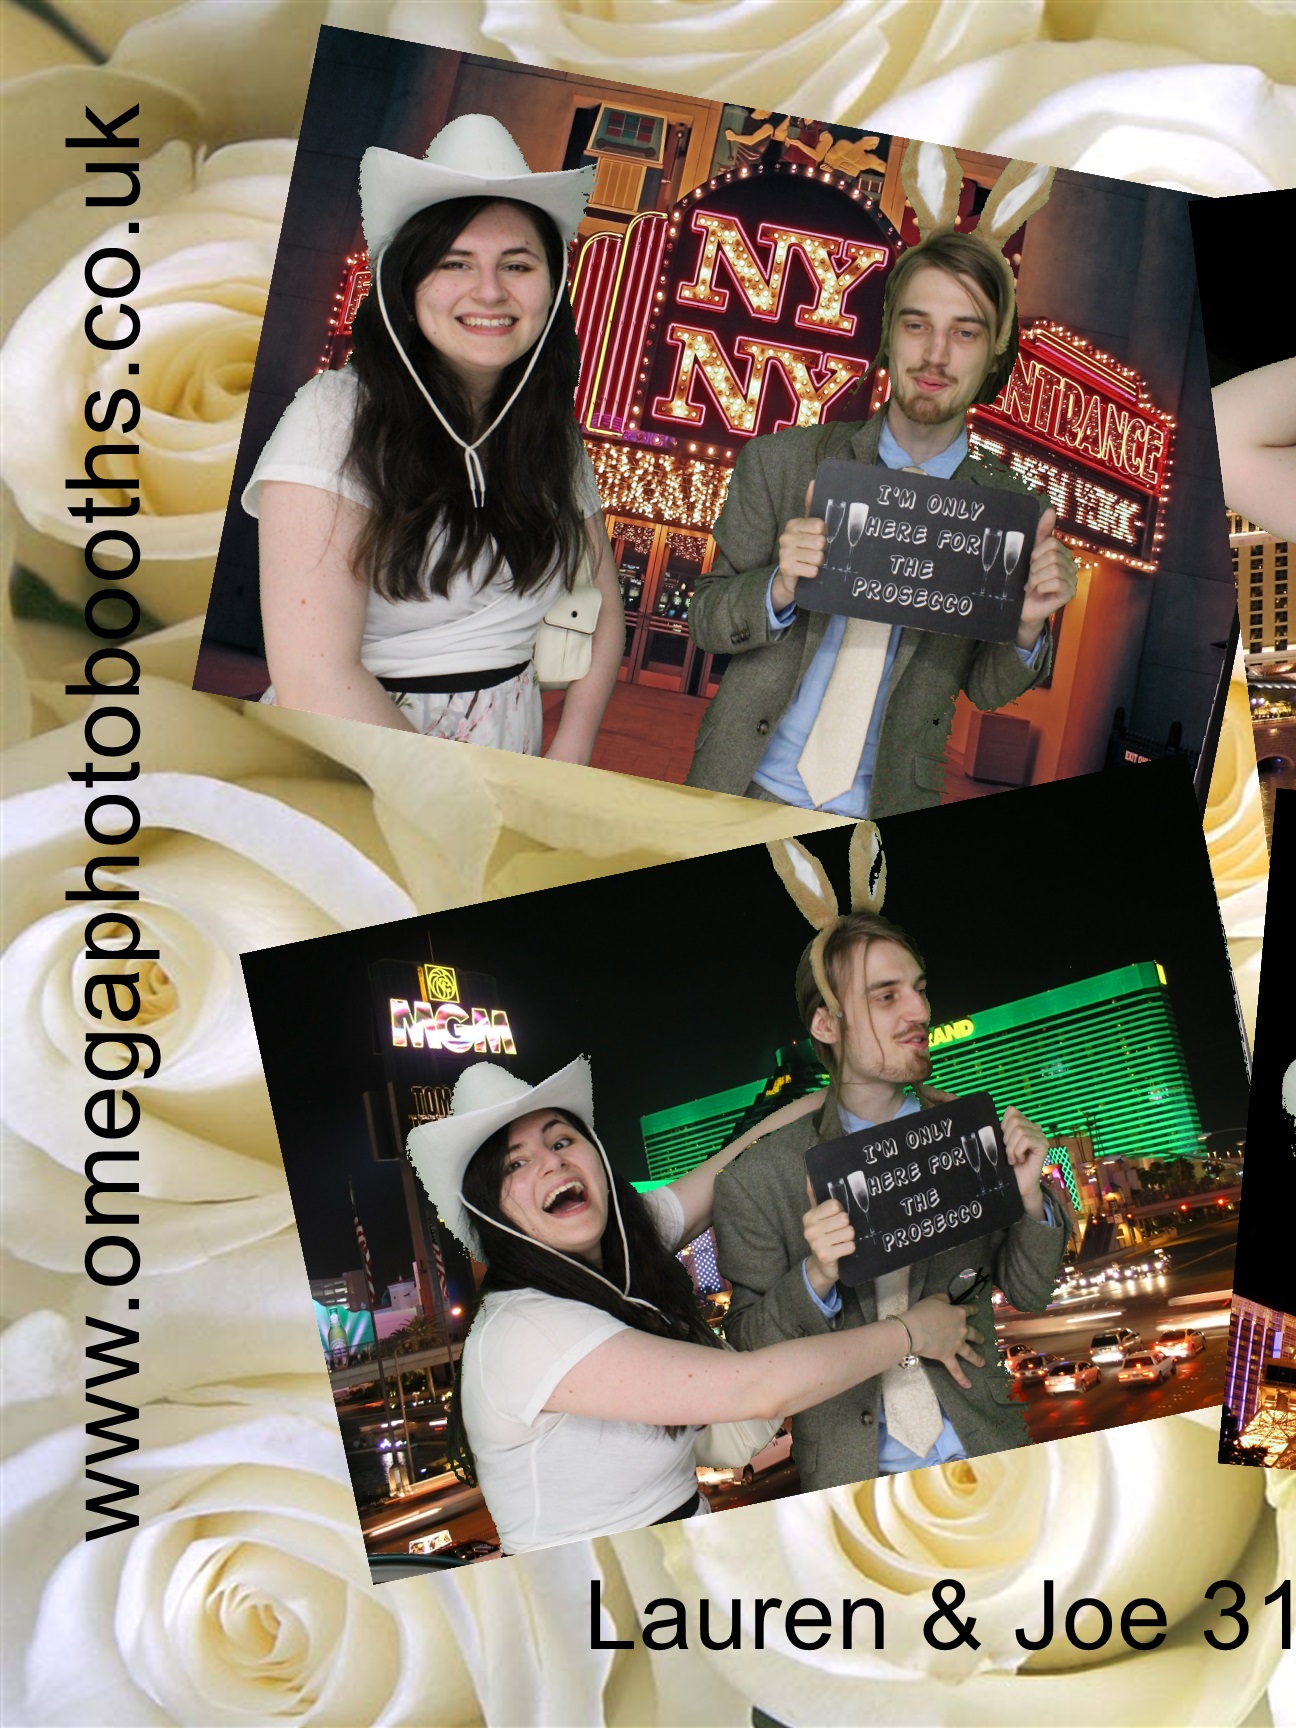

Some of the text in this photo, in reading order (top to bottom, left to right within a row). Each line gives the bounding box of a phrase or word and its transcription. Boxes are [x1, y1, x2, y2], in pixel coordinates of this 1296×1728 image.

[677, 209, 889, 336] NY
[652, 323, 870, 436] NY
[992, 352, 1164, 485] NTRANCE
[877, 485, 984, 521] I'M ONLY
[865, 516, 980, 555] HERE FOR
[890, 555, 934, 580] THE
[852, 577, 973, 616] PROSECCO
[389, 997, 518, 1055] MGM
[862, 1118, 952, 1164] I'M ONLY
[867, 1147, 966, 1196] HERE FOR
[900, 1188, 940, 1216] THE
[882, 1200, 982, 1252] PROSECCO
